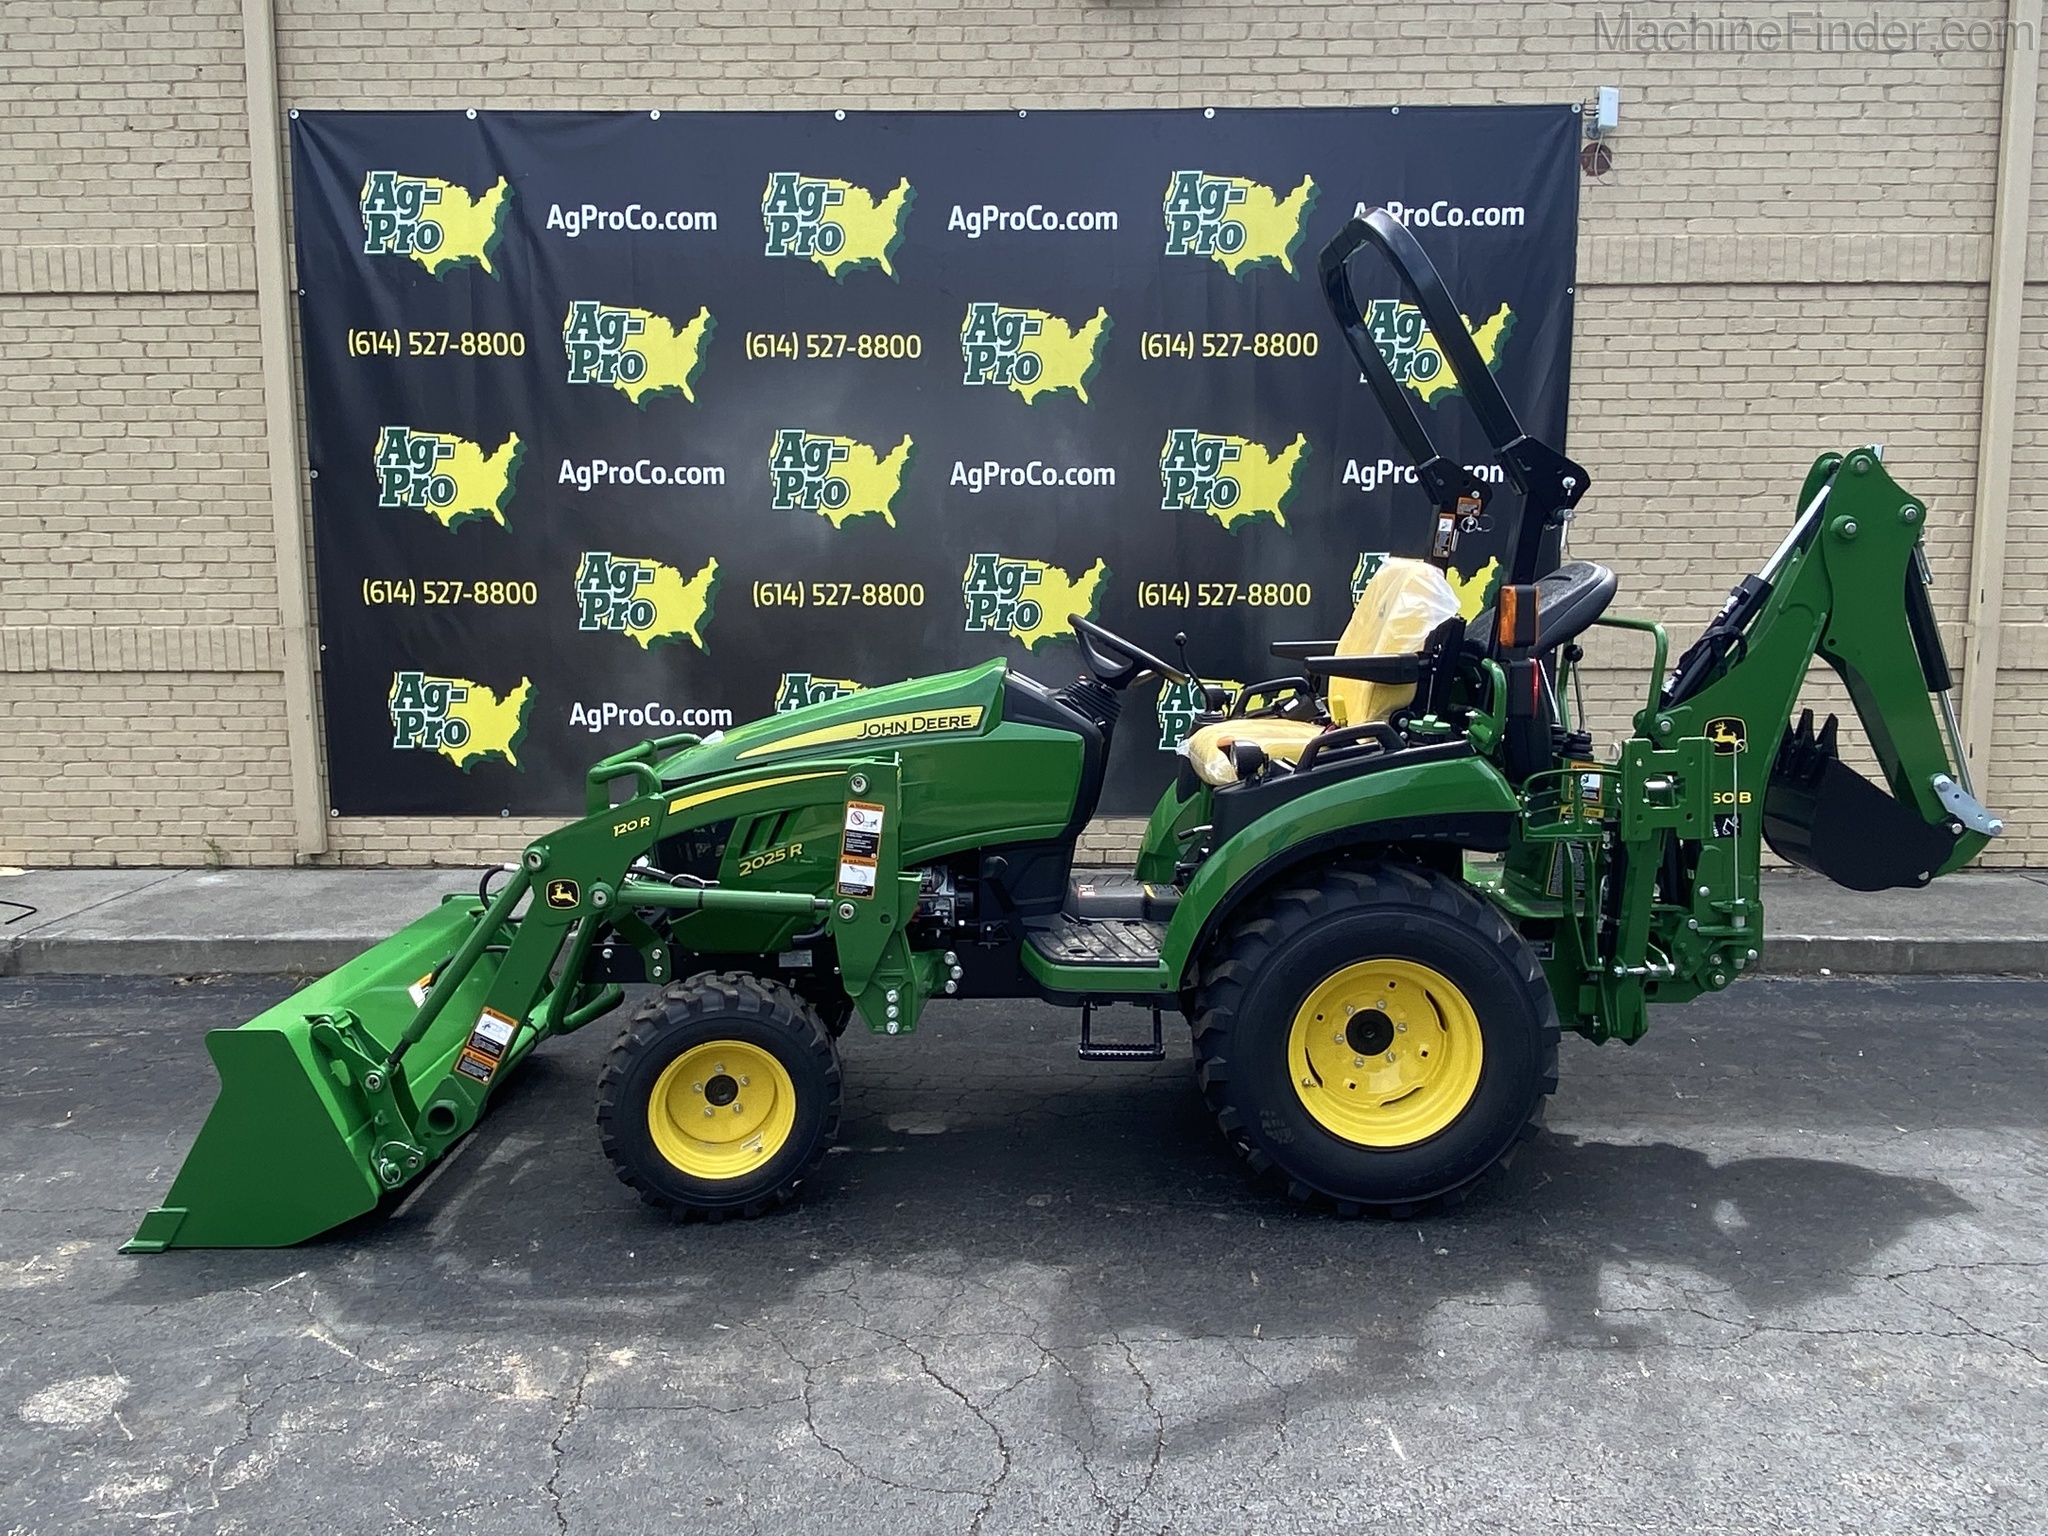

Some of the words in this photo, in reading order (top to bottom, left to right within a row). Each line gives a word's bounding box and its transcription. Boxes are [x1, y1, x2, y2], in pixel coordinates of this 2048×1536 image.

[363, 171, 441, 220] Ag-
[763, 172, 844, 221] Ag-
[1165, 171, 1246, 220] Ag-
[1353, 200, 1525, 227] AProCo.com
[364, 212, 443, 254] Pro
[546, 203, 718, 238] AgProCo.com
[764, 213, 846, 255] Pro
[947, 204, 1119, 239] AgProCo.com
[1165, 212, 1246, 255] Pro
[348, 328, 401, 358] (614)
[408, 331, 526, 357] 527-8800
[566, 301, 645, 350] Ag-
[745, 331, 799, 361] (614)
[806, 333, 922, 359] 527-8800
[962, 303, 1041, 352] Ag-
[1141, 330, 1195, 361] (614)
[1202, 332, 1319, 358] 527-8800
[567, 342, 647, 384] Pro
[963, 344, 1043, 385] Pro
[376, 426, 455, 475] Ag-
[771, 429, 849, 477] Ag-
[1162, 429, 1241, 477] Ag-
[378, 466, 457, 507] Pro
[558, 459, 725, 492] AgProCo.com
[771, 468, 850, 509] Pro
[949, 460, 1116, 493] AgProCo.com
[1161, 468, 1240, 509] Pro
[363, 578, 416, 606] (614)
[423, 581, 538, 605] 527-8800
[577, 552, 654, 600] Ag-
[752, 580, 805, 608] (614)
[812, 583, 925, 606] 527-8800
[964, 553, 1042, 600] Ag-
[1138, 581, 1190, 609] (614)
[1197, 582, 1311, 606] 527-8800
[578, 590, 657, 631] Pro
[965, 592, 1042, 631] Pro
[391, 672, 468, 718] Ag-
[393, 709, 470, 748] Pro
[568, 701, 734, 733] AgProCo.com
[857, 720, 908, 739] JOHN
[912, 715, 973, 733] DEERE
[613, 821, 638, 838] 120
[640, 816, 651, 828] R
[738, 848, 787, 877] 2025
[789, 842, 803, 858] R
